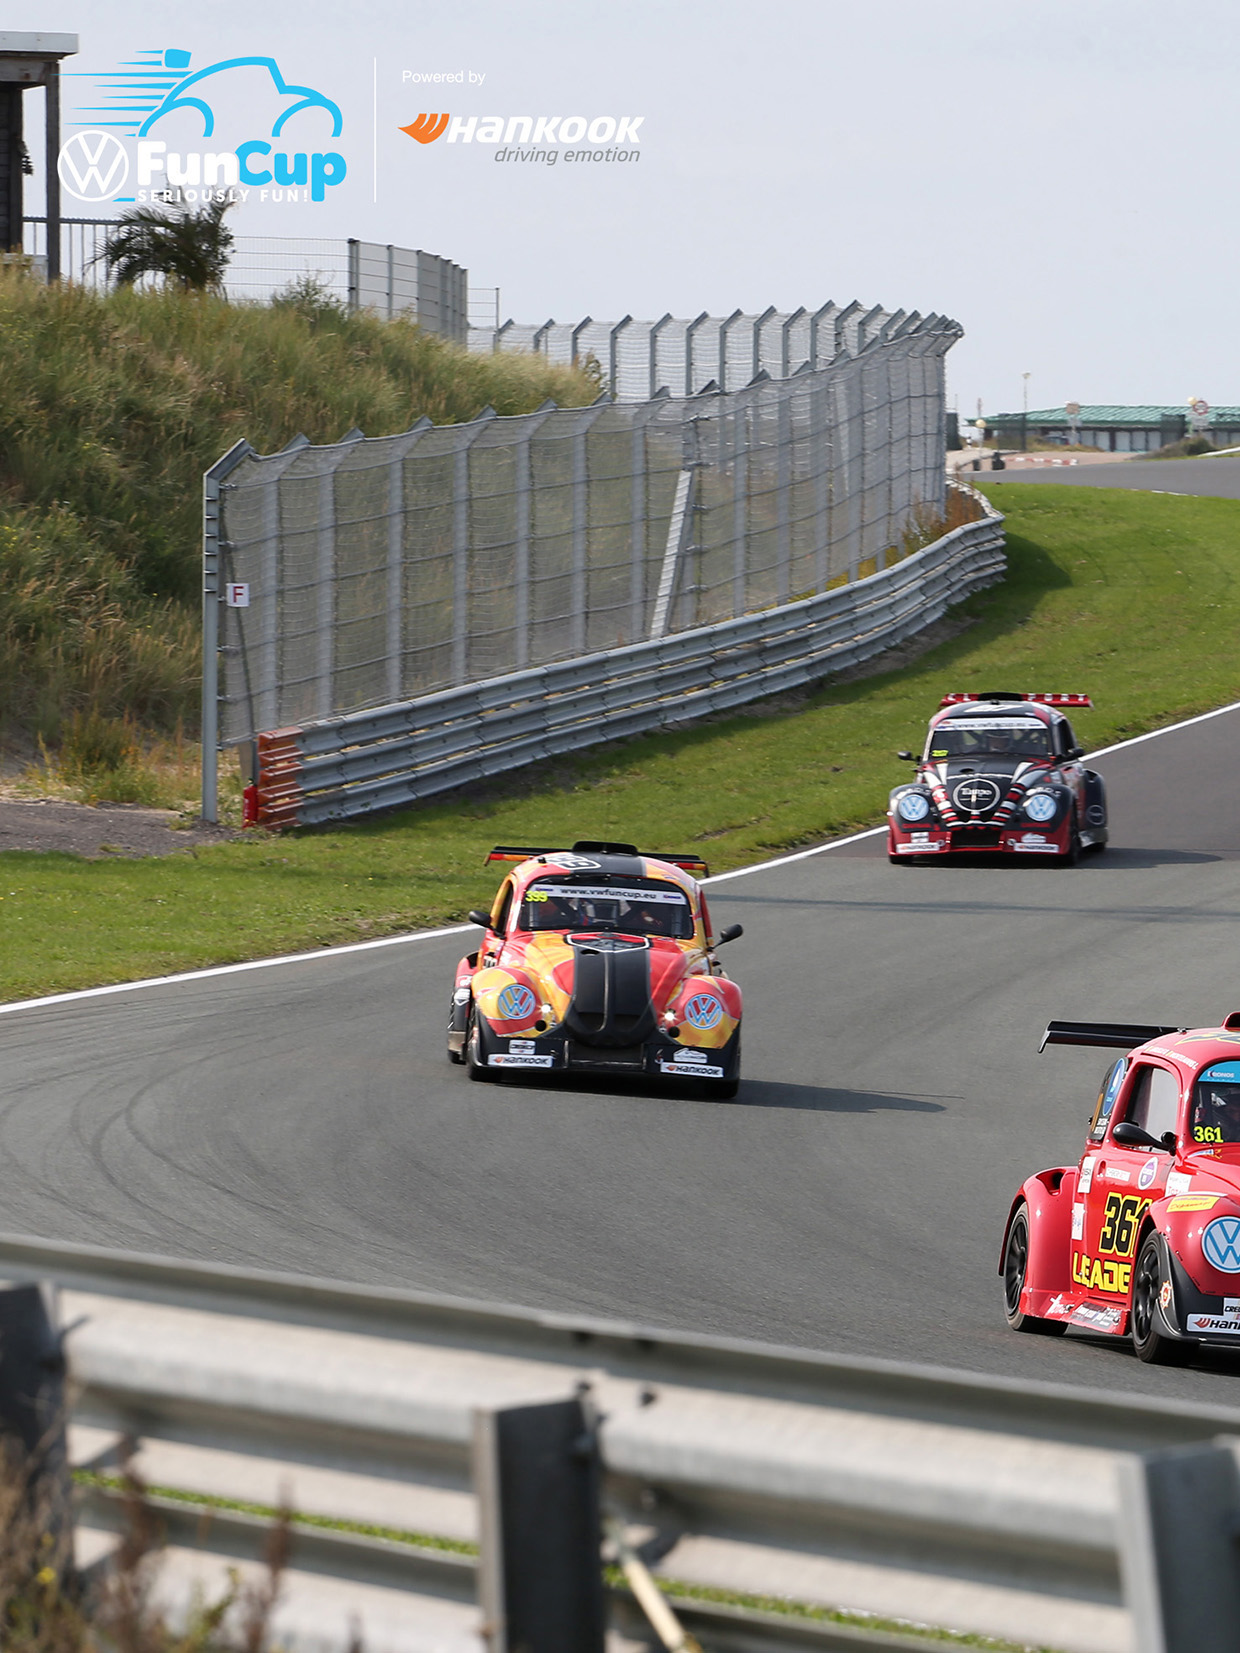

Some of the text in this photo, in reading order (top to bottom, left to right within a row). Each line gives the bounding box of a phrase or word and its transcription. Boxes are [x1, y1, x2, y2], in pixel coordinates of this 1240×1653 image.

[233, 586, 244, 603] F
[947, 693, 1086, 701] CLPORT
[525, 891, 548, 902] 399
[560, 887, 657, 900] www.vwfuncup.eu
[1194, 1126, 1223, 1143] 361
[1072, 1252, 1132, 1294] LEADE
